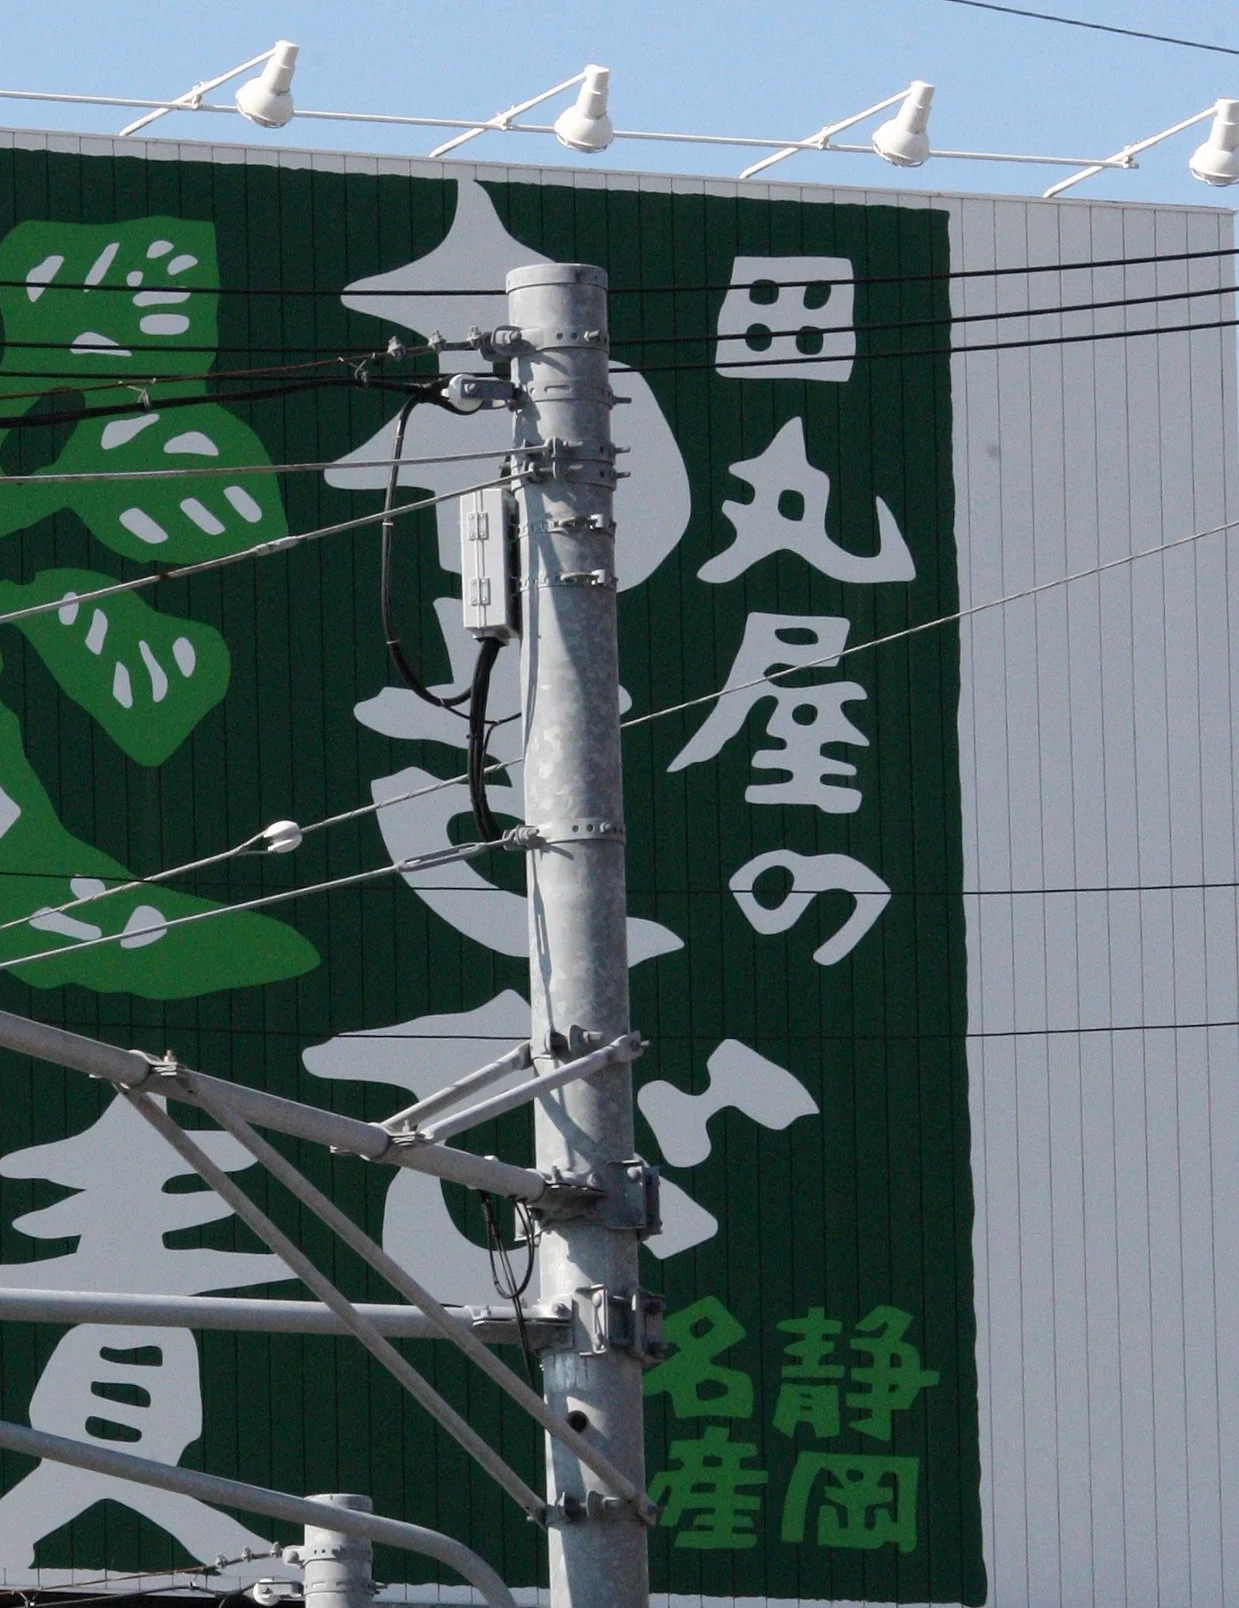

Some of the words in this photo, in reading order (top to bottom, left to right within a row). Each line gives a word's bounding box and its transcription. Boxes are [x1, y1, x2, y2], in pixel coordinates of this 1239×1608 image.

[667, 255, 917, 967] 田丸屋の
[642, 1295, 768, 1550] 名産
[770, 1305, 940, 1552] 静岡
